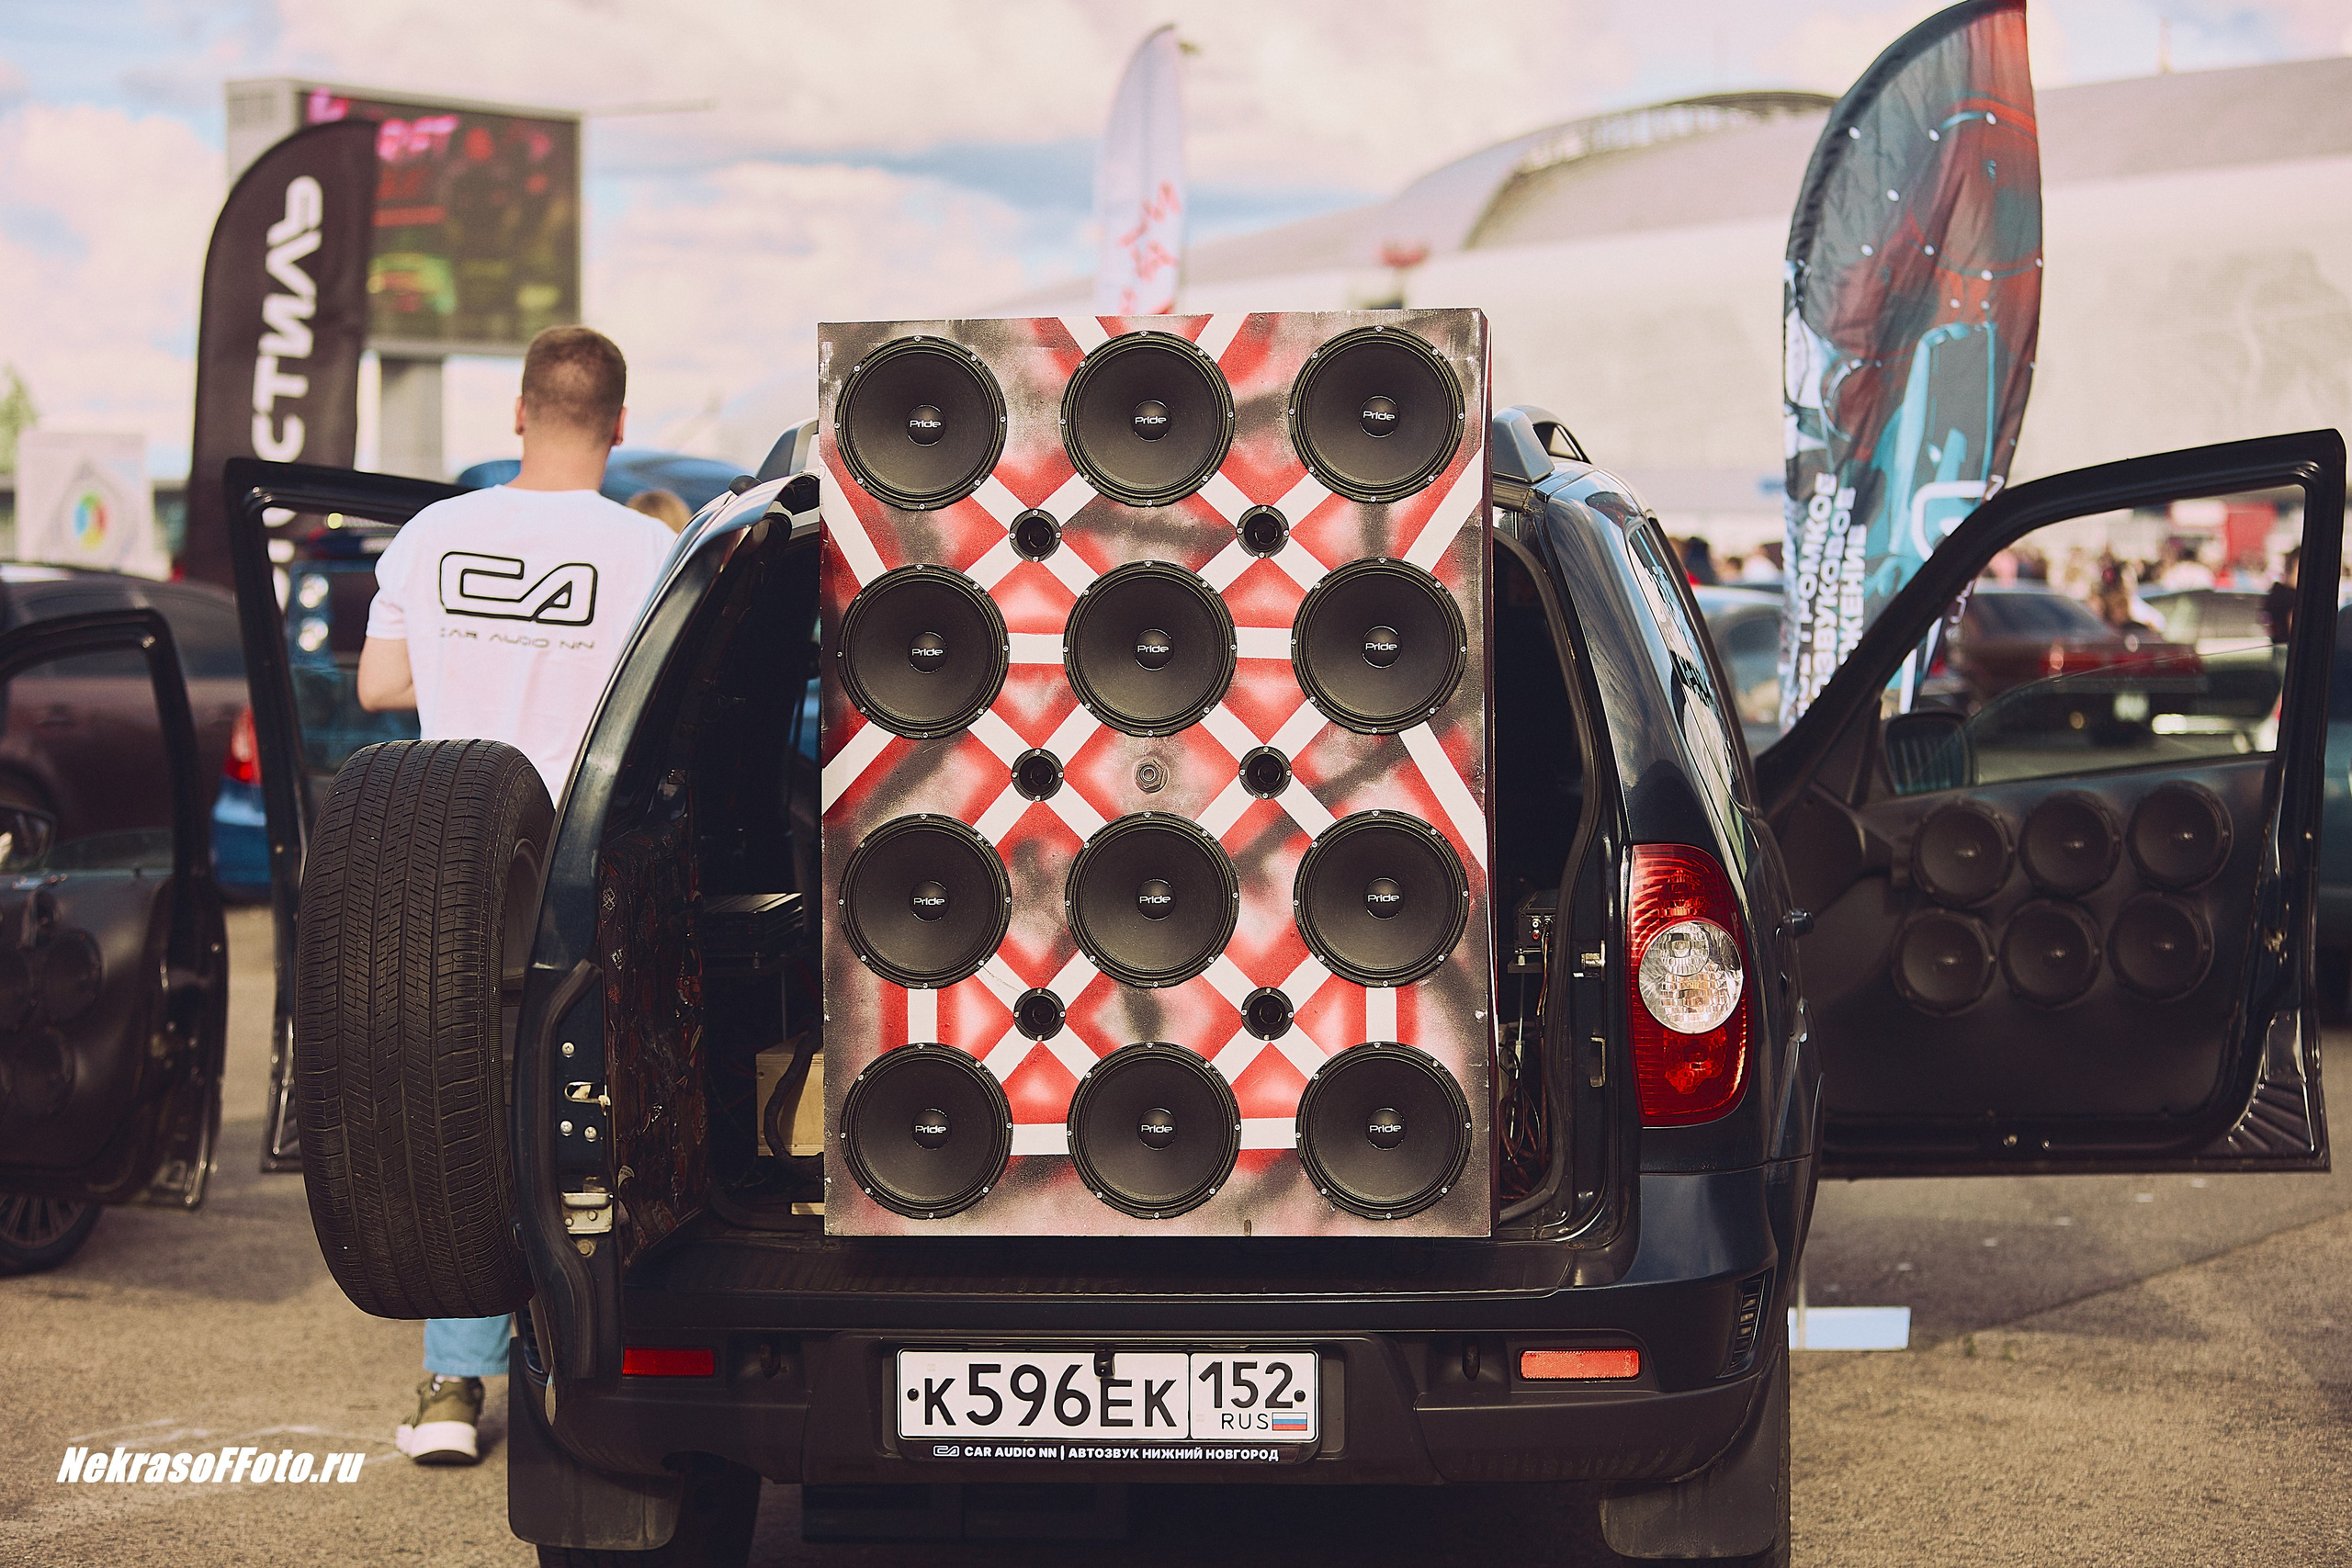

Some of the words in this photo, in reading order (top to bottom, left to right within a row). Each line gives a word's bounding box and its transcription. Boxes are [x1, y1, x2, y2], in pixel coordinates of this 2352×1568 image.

[1135, 416, 1167, 424] Pride
[1363, 411, 1396, 421] Pride
[910, 420, 942, 428] Pride
[1136, 645, 1169, 653] Pride
[1365, 642, 1397, 651] Pride
[911, 649, 944, 658] Pride
[913, 897, 945, 906] Pride
[1139, 896, 1171, 904] Pride
[1368, 894, 1401, 903] Pride
[915, 1125, 947, 1134] Pride
[1140, 1124, 1173, 1134] Pride
[1369, 1124, 1402, 1134] Pride
[1198, 1360, 1294, 1410] 152
[1221, 1412, 1270, 1431] RUS
[964, 1446, 992, 1458] CAR
[994, 1447, 1036, 1459] AUDIO
[1038, 1447, 1057, 1460] NN
[1068, 1448, 1140, 1460] АВТОЗВУК
[1142, 1446, 1203, 1461] НИЖНИЙ
[1204, 1450, 1280, 1462] НОВГОРОД
